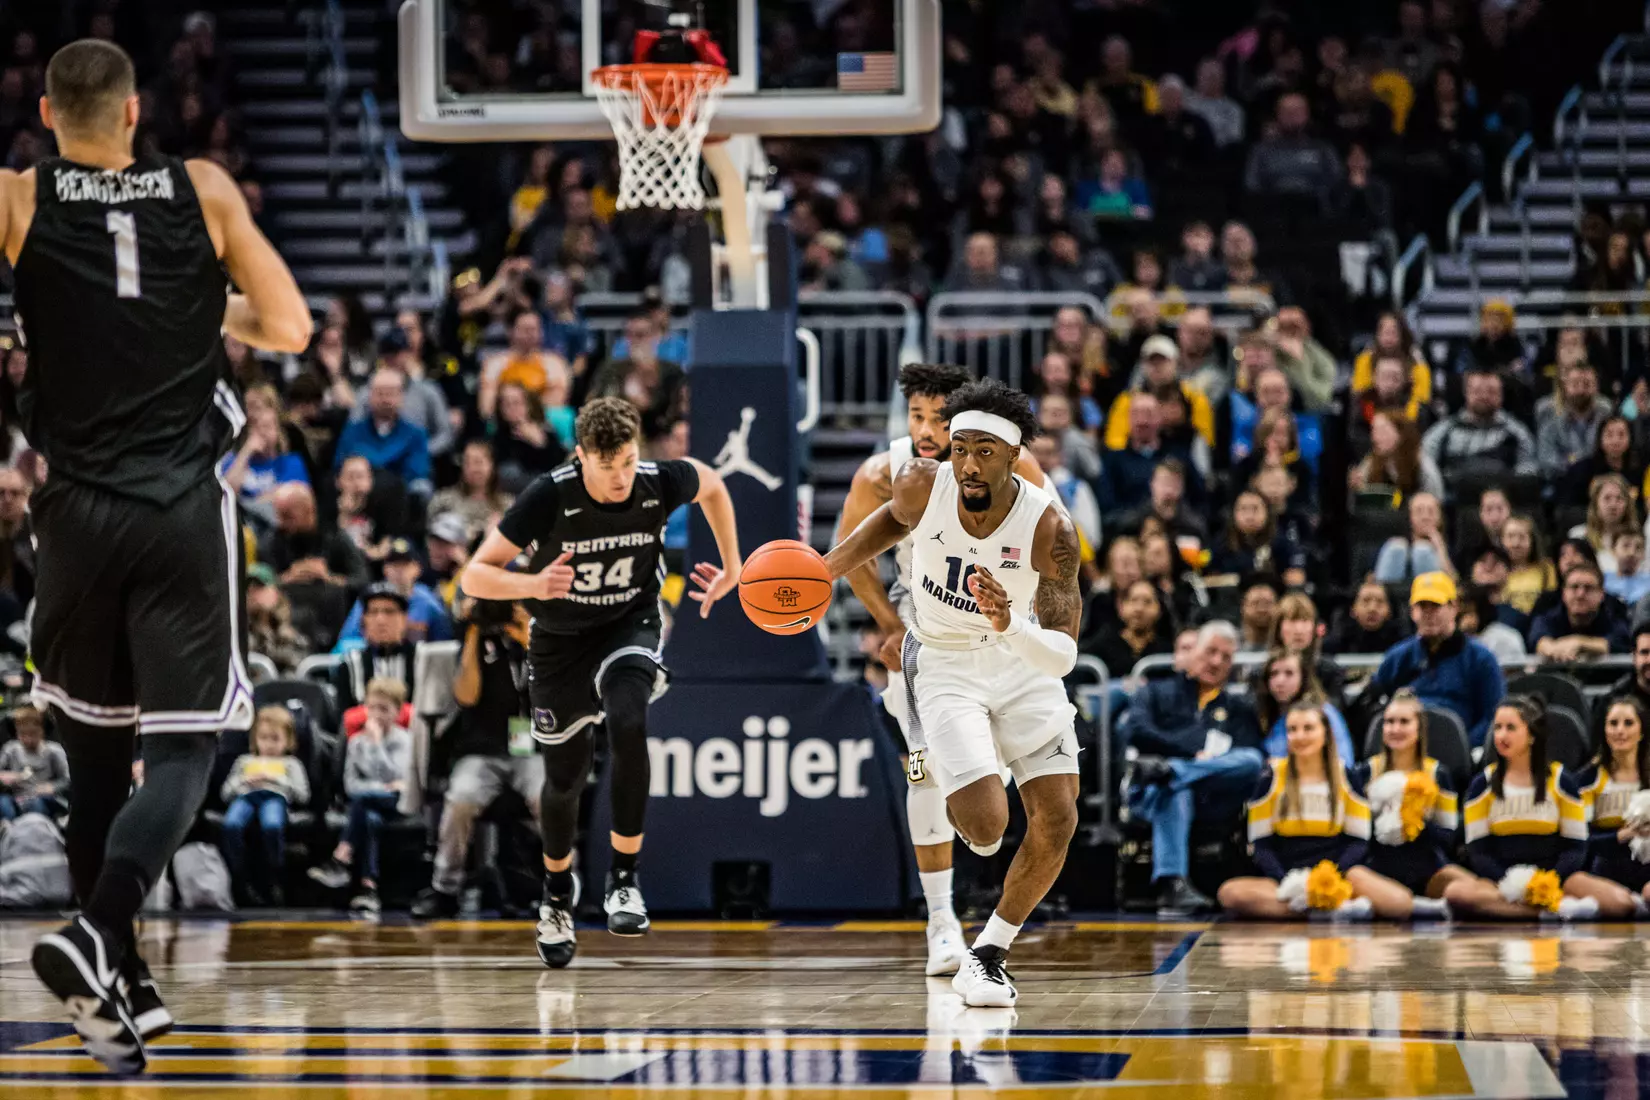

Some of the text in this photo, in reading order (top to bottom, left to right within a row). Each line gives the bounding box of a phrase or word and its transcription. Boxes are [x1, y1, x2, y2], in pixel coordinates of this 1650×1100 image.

[106, 209, 140, 298] 1
[561, 532, 655, 554] CENTRAL
[574, 556, 635, 592] 34
[922, 574, 1013, 615] MARQU
[646, 715, 874, 818] meijer
